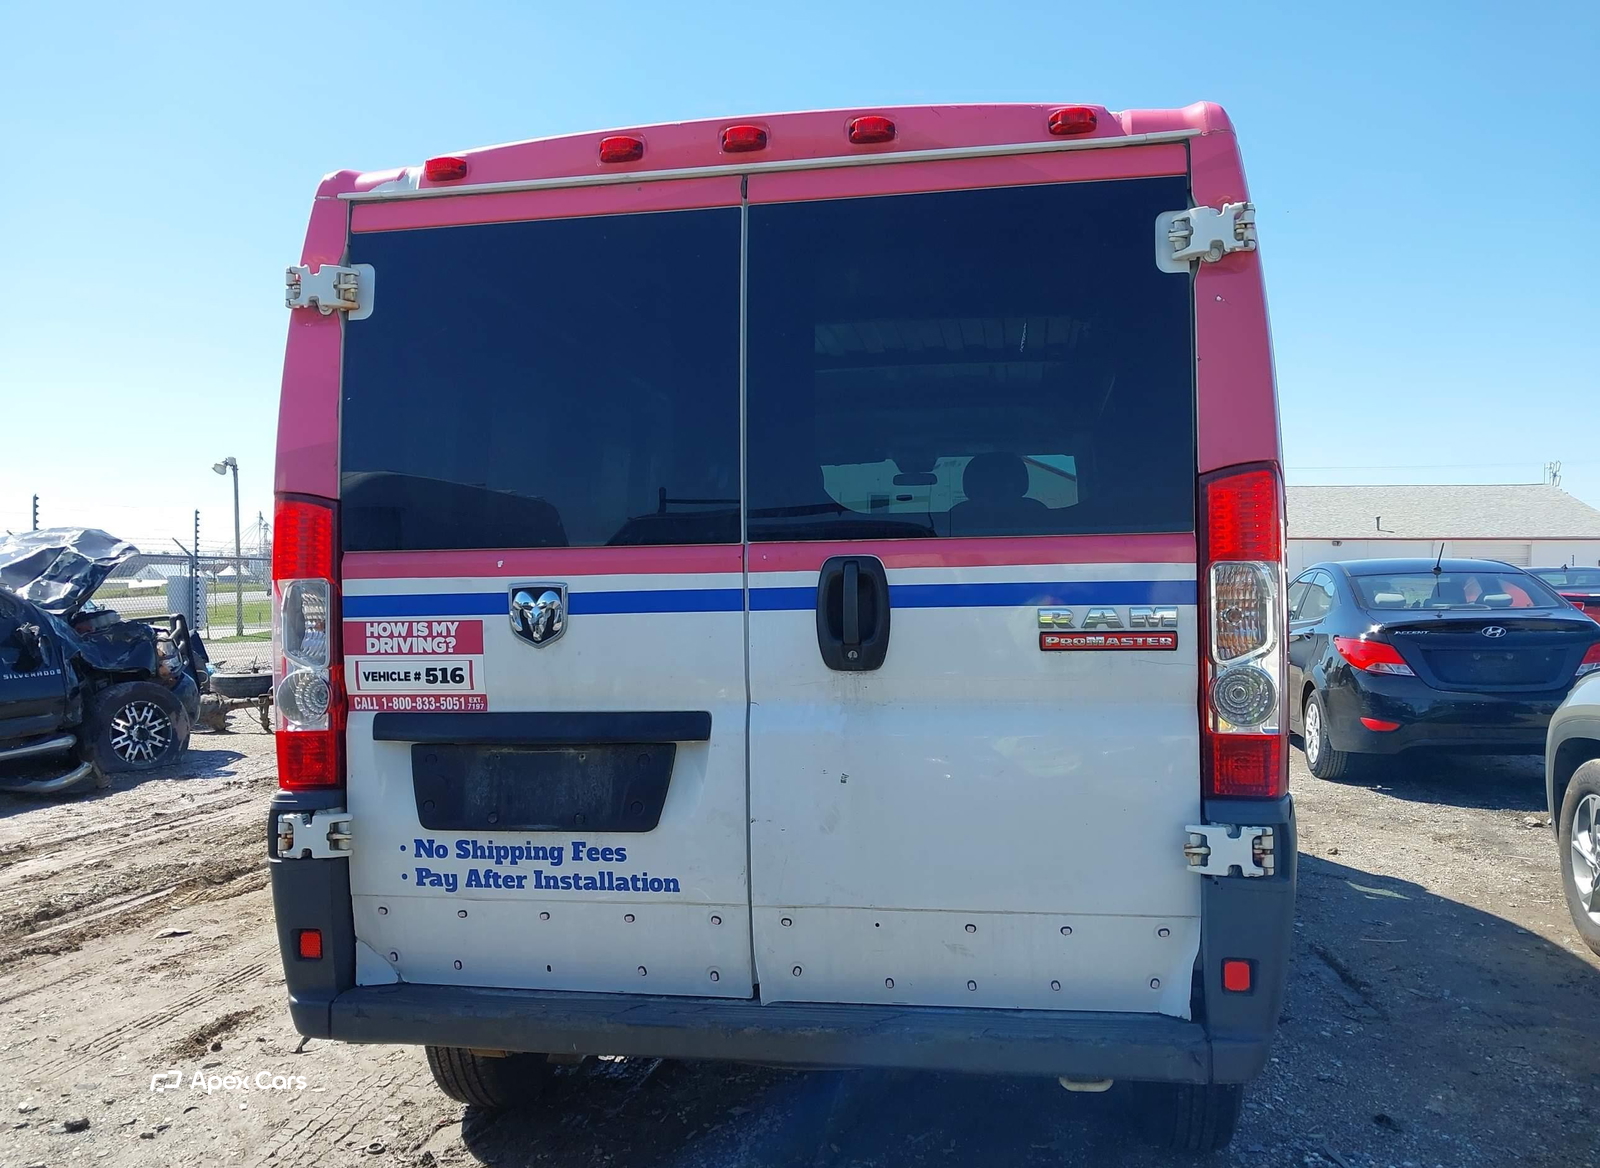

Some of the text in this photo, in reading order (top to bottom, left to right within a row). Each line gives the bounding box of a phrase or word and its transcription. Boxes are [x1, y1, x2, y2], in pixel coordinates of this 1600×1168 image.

[1038, 607, 1179, 629] RAM
[366, 621, 459, 637] HOW IS MY
[366, 637, 457, 653] DRIVING?
[363, 667, 465, 684] VEHICLE # 516
[354, 696, 465, 710] CALL 1-800-833-5051
[414, 839, 627, 866] No Shipping Fees
[415, 868, 681, 893] Pay After Installation
